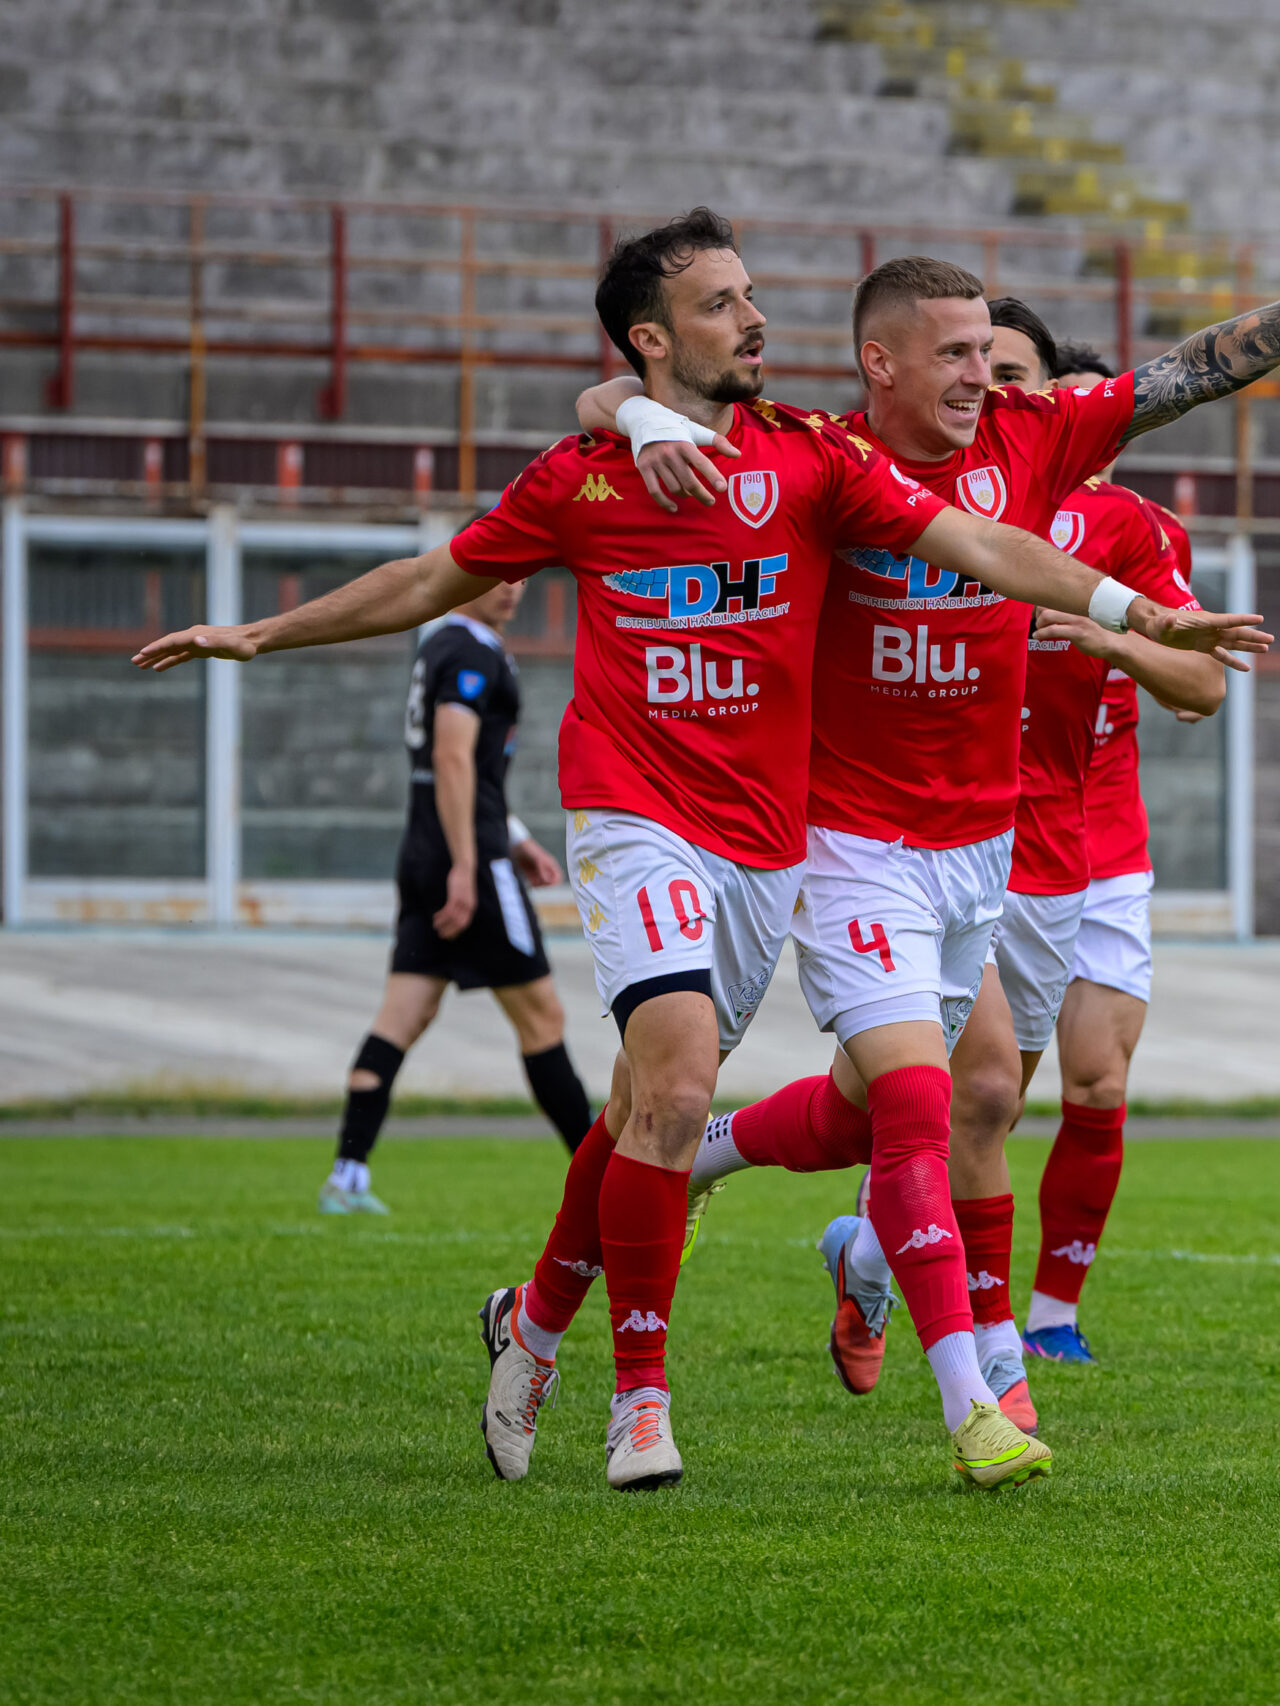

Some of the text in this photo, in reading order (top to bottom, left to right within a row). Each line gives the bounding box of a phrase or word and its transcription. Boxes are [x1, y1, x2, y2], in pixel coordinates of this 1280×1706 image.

[743, 472, 762, 485] 1910
[969, 470, 987, 485] 1910
[1054, 512, 1070, 522] 910
[668, 553, 788, 619] DHF
[849, 591, 924, 610] DISTRIBUTION
[926, 596, 981, 610] HANDLING
[616, 602, 790, 629] DISTRIBUTION HANDLING FACILITY
[872, 625, 980, 683] Blu.
[1029, 640, 1071, 651] FACILITY
[645, 643, 759, 703] Blu.
[870, 685, 978, 698] MEDIA GROUP
[648, 703, 759, 719] MEDIA GROUP
[636, 879, 709, 952] 10
[847, 918, 896, 973] 4
